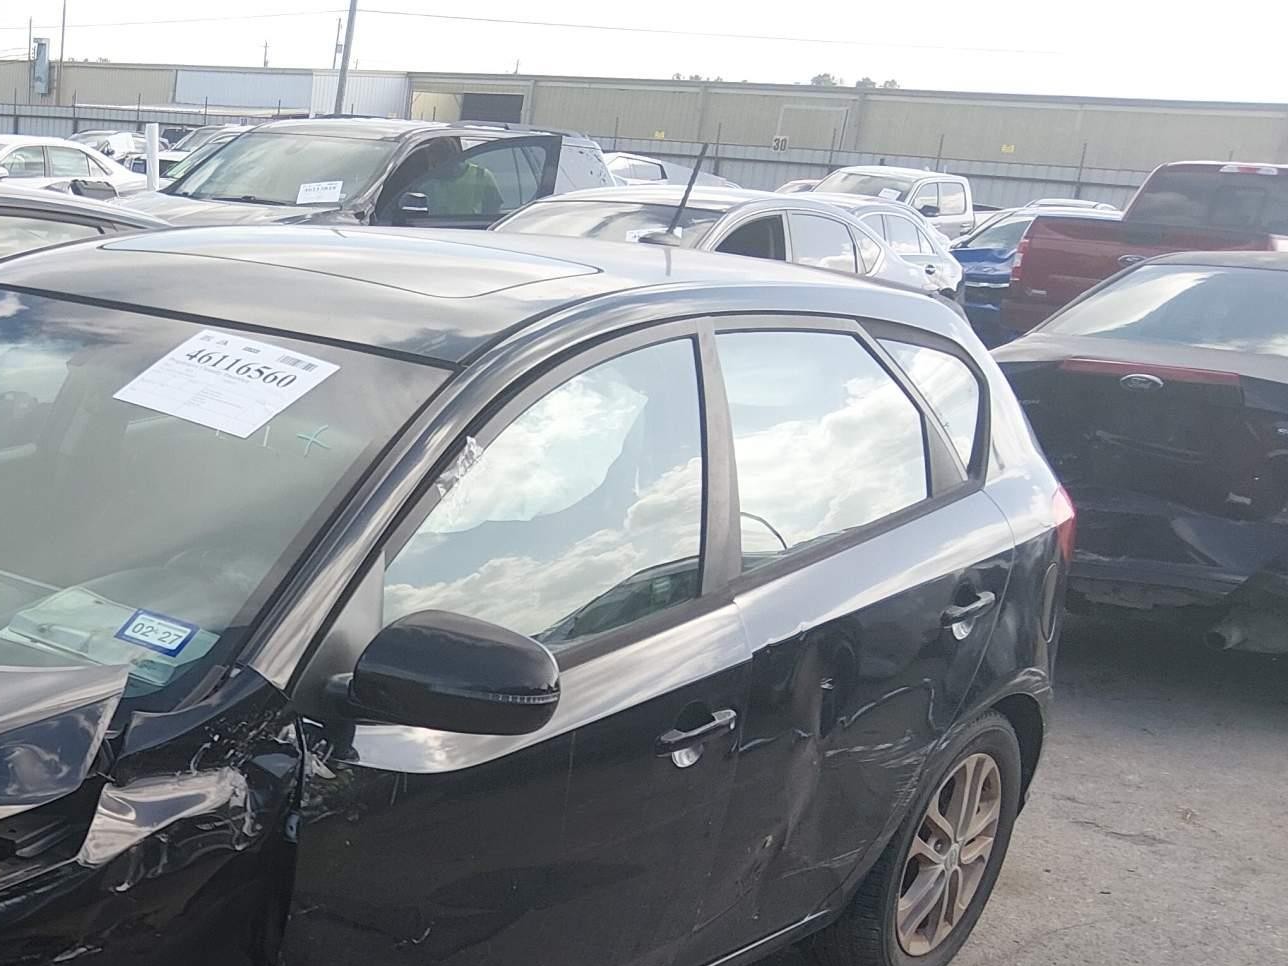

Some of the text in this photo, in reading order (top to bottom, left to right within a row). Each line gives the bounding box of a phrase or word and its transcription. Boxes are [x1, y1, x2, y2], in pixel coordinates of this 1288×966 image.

[773, 138, 787, 151] 30
[186, 348, 298, 388] 46116560
[132, 622, 154, 637] 02
[157, 630, 183, 645] 27
